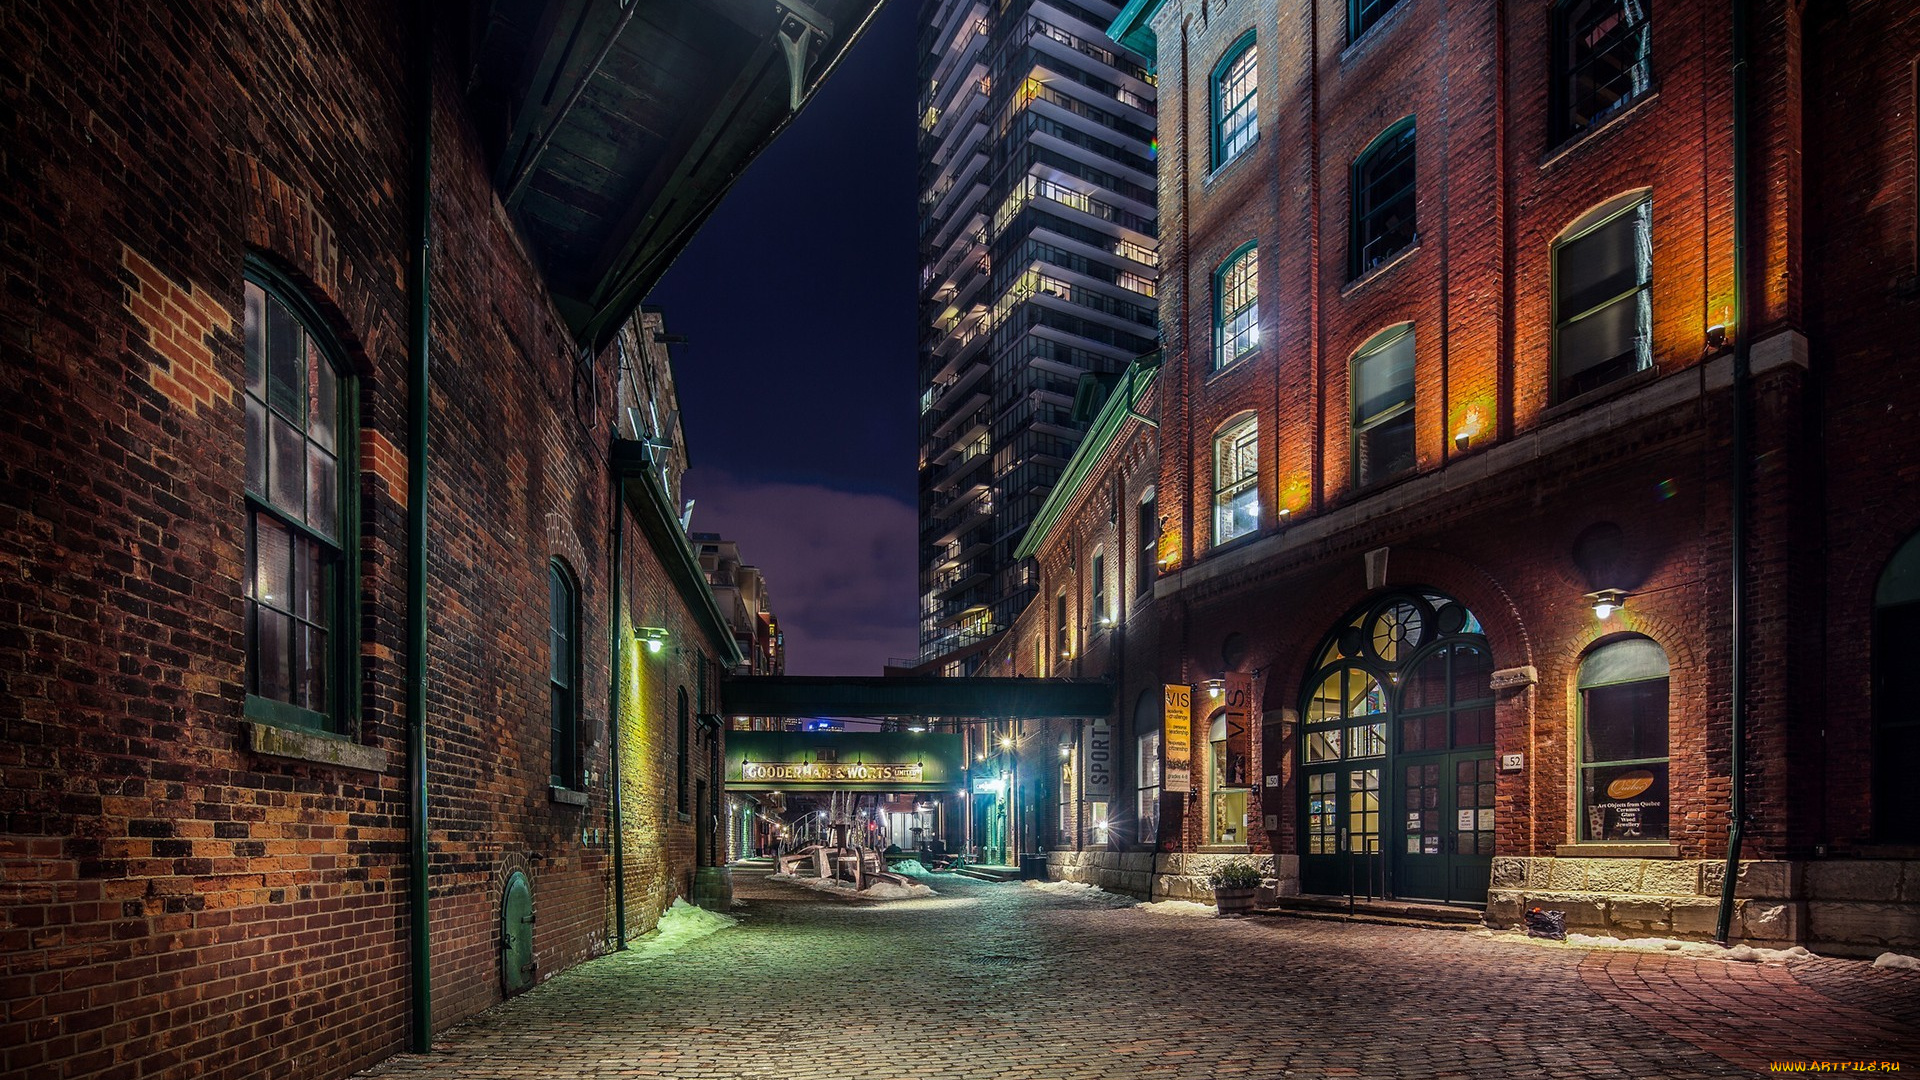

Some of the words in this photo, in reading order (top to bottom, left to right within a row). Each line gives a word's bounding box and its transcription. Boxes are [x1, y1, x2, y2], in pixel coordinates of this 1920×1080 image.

[1167, 692, 1190, 708] VIS
[1227, 689, 1245, 739] VIS
[1090, 727, 1110, 785] SPORT
[1510, 757, 1521, 767] 52
[846, 766, 892, 779] WORTS
[1270, 777, 1278, 785] 50
